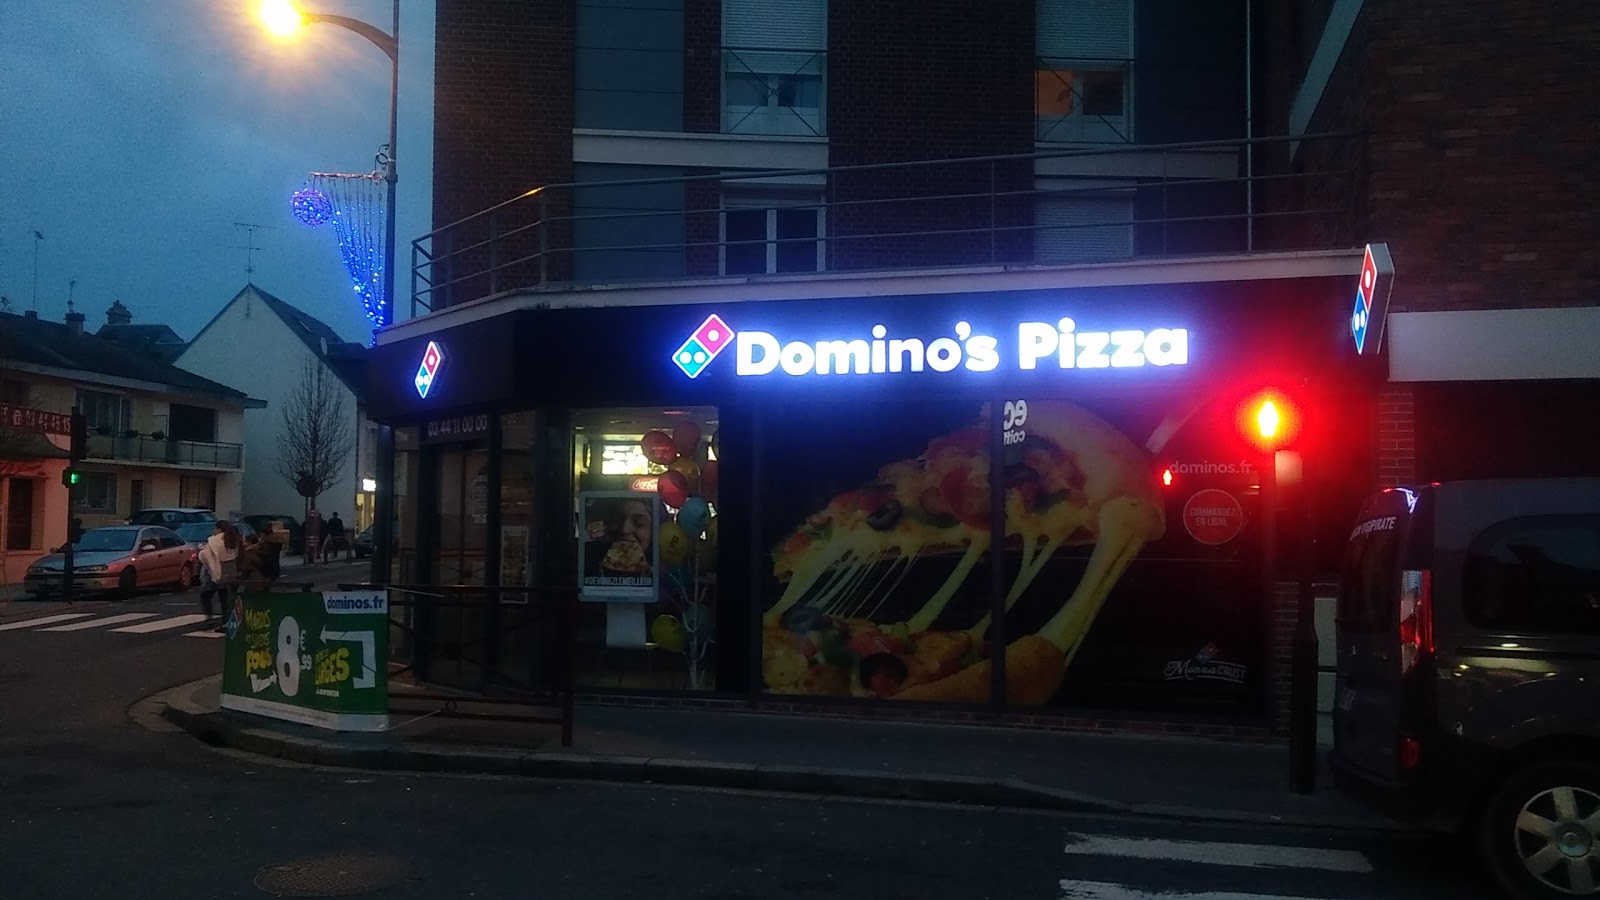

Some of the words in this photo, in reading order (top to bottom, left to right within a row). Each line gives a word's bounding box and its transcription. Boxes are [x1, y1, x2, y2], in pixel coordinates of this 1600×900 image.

[736, 321, 999, 376] Domino's
[1018, 317, 1189, 370] Pizza
[428, 421, 438, 436] 03
[440, 418, 451, 434] 44
[462, 416, 474, 432] 00
[475, 415, 488, 431] 00
[1169, 460, 1252, 474] dominos.fr
[1189, 507, 1237, 517] COMMANDEZ
[1196, 516, 1207, 526] EN
[1208, 516, 1228, 527] LIGNE
[327, 596, 384, 610] dominos.fr
[276, 616, 300, 697] 8
[1217, 664, 1247, 680] CRUST
